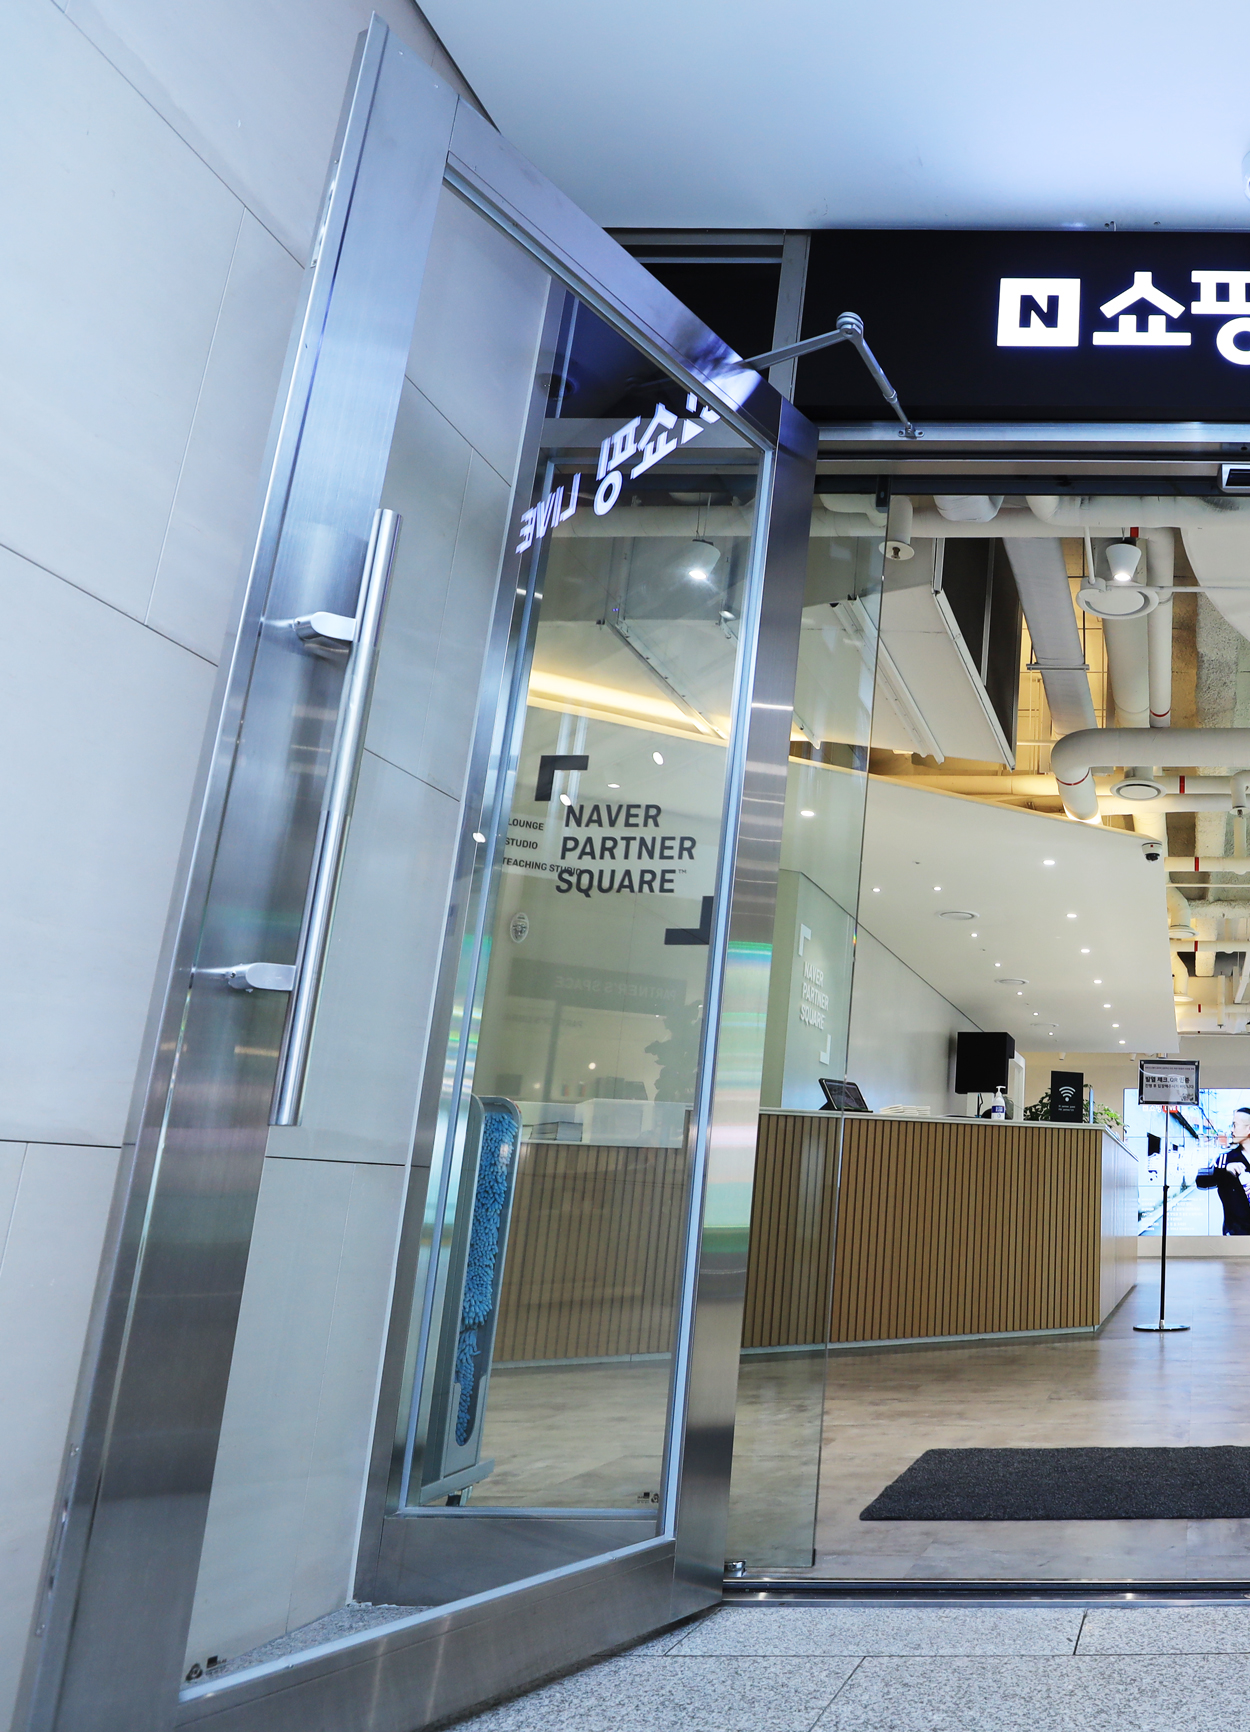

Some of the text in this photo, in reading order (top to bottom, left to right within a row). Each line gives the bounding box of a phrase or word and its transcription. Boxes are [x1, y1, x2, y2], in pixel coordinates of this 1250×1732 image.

[508, 818, 545, 831] LOUNGE
[564, 804, 662, 828] NAVER
[505, 837, 538, 850] STUDIO
[560, 836, 696, 860] PARTNER
[502, 857, 547, 871] TEACHING
[555, 868, 676, 898] SQUARE
[804, 961, 823, 987] NAVER
[801, 982, 829, 1011] PARTNER
[800, 1004, 825, 1030] SQUARE
